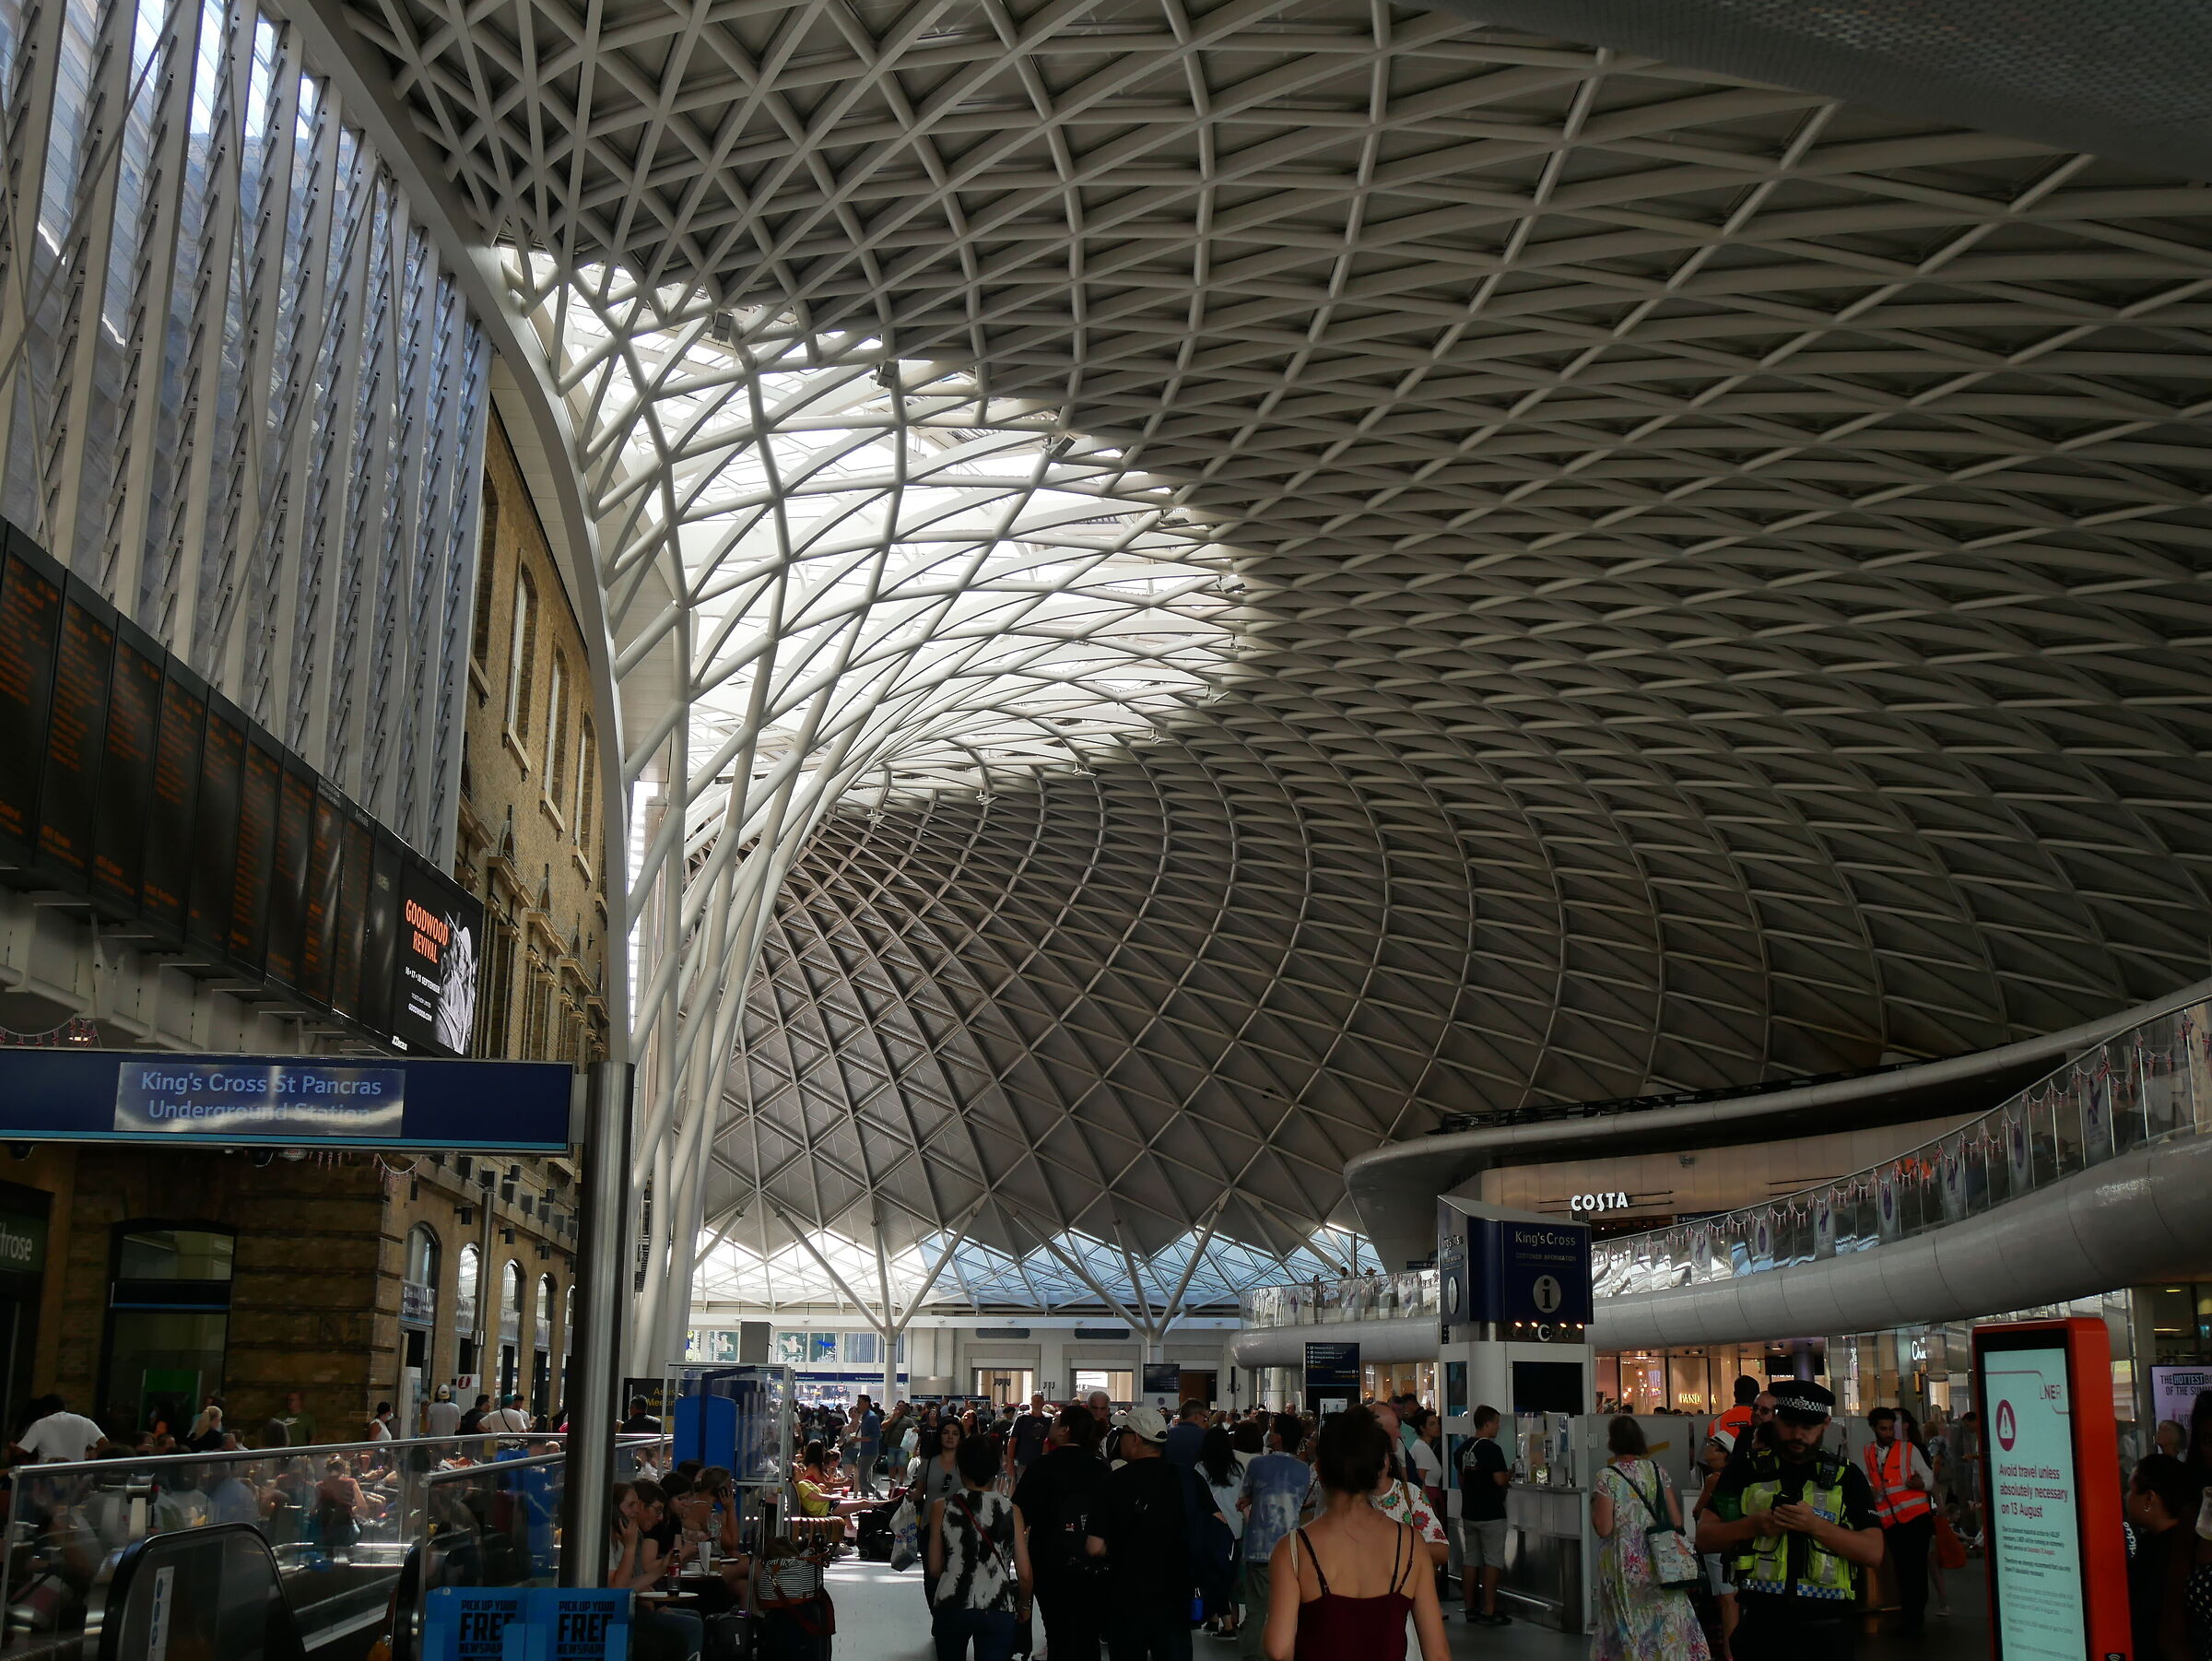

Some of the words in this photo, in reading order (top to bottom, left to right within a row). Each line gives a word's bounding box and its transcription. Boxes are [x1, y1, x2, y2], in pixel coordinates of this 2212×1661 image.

[406, 899, 449, 947] GOODWOOD
[412, 930, 438, 964] REVIVAL
[421, 976, 441, 995] SEPTEMBER
[142, 1071, 203, 1096] King's
[209, 1073, 267, 1093] Cross
[274, 1073, 296, 1094] St
[301, 1075, 382, 1096] Pancras
[148, 1099, 288, 1122] Underground
[294, 1102, 369, 1121] Station
[1571, 1191, 1629, 1212] COSTA
[0, 1222, 33, 1262] trose
[1515, 1231, 1546, 1247] King's
[1547, 1231, 1576, 1246] Cross
[1543, 1254, 1577, 1262] INFORMATION
[2160, 1374, 2173, 1384] THE
[2173, 1374, 2203, 1384] HOTTEST
[2039, 1384, 2062, 1400] LNER
[2166, 1385, 2174, 1396] OF
[2176, 1385, 2188, 1396] THE
[1999, 1463, 2018, 1477] Avoid
[2018, 1464, 2038, 1478] travel
[2038, 1466, 2060, 1480] unless
[2000, 1482, 2034, 1500] absolutely
[2034, 1487, 2068, 1502] necessary
[2001, 1503, 2010, 1514] on
[2010, 1502, 2018, 1515] 13
[2019, 1503, 2043, 1519] August
[462, 1600, 481, 1610] PICK
[481, 1600, 493, 1611] UP
[495, 1600, 518, 1611] YOUR
[559, 1601, 577, 1611] PICK
[579, 1601, 591, 1612] UP
[593, 1601, 615, 1612] YOUR
[557, 1644, 605, 1655] NEWSPAP
